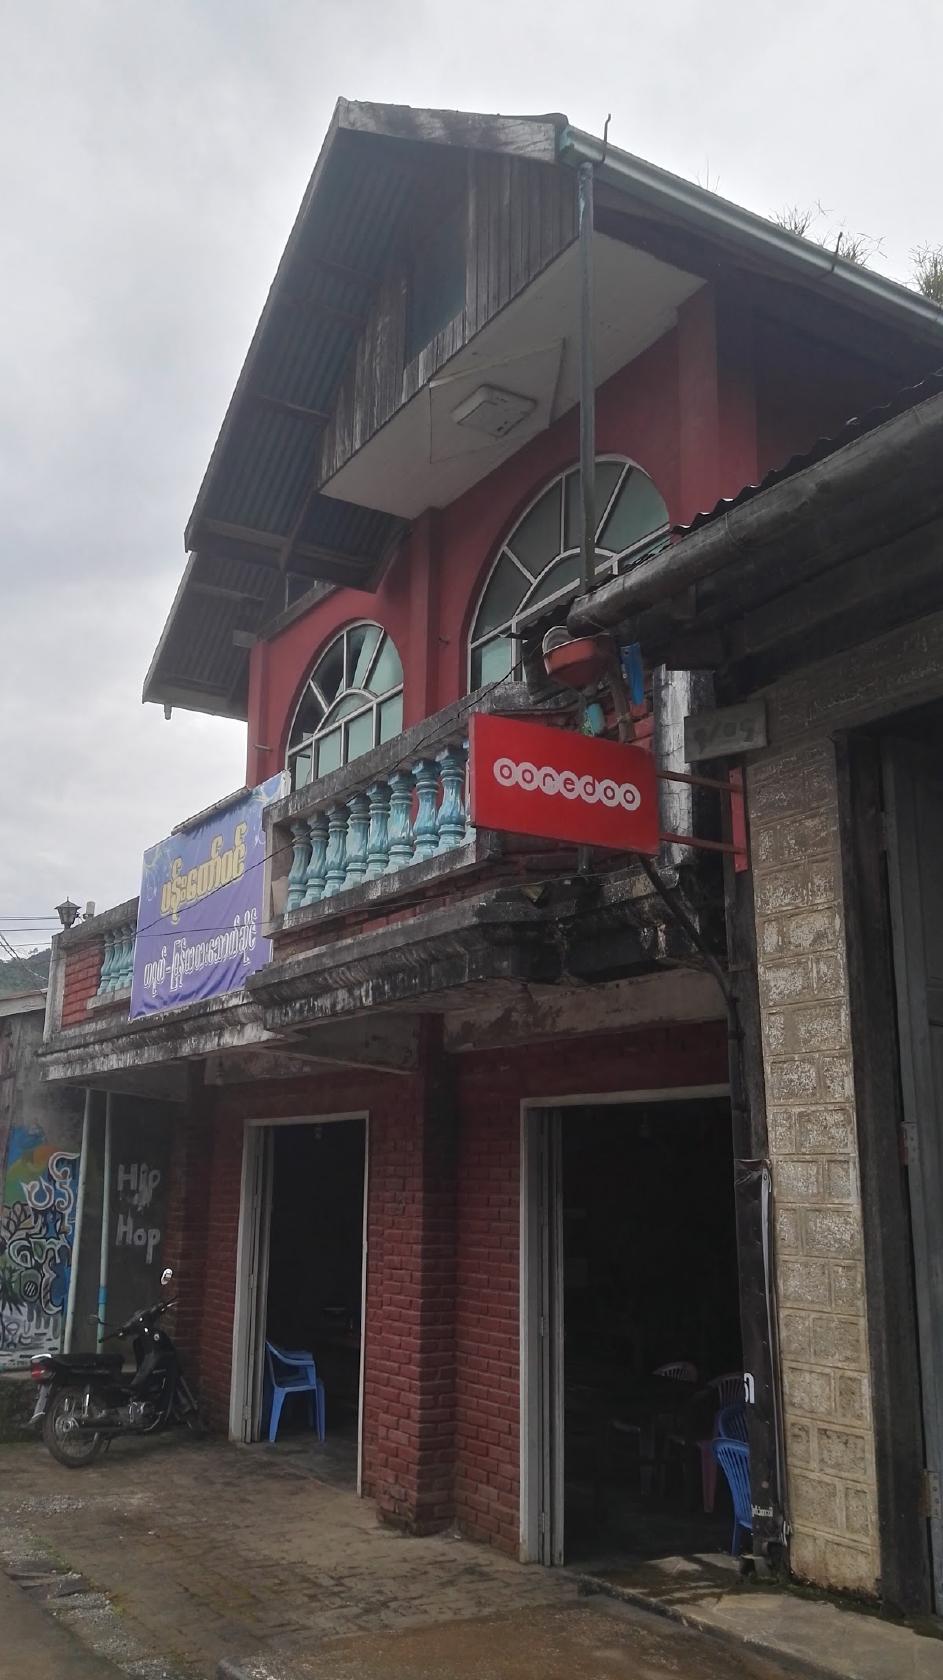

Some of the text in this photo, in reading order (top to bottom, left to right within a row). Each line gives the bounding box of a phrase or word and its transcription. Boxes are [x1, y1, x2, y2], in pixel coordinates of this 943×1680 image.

[493, 757, 641, 811] ooredoo
[117, 1163, 161, 1203] Hip
[115, 1212, 161, 1264] Hop
